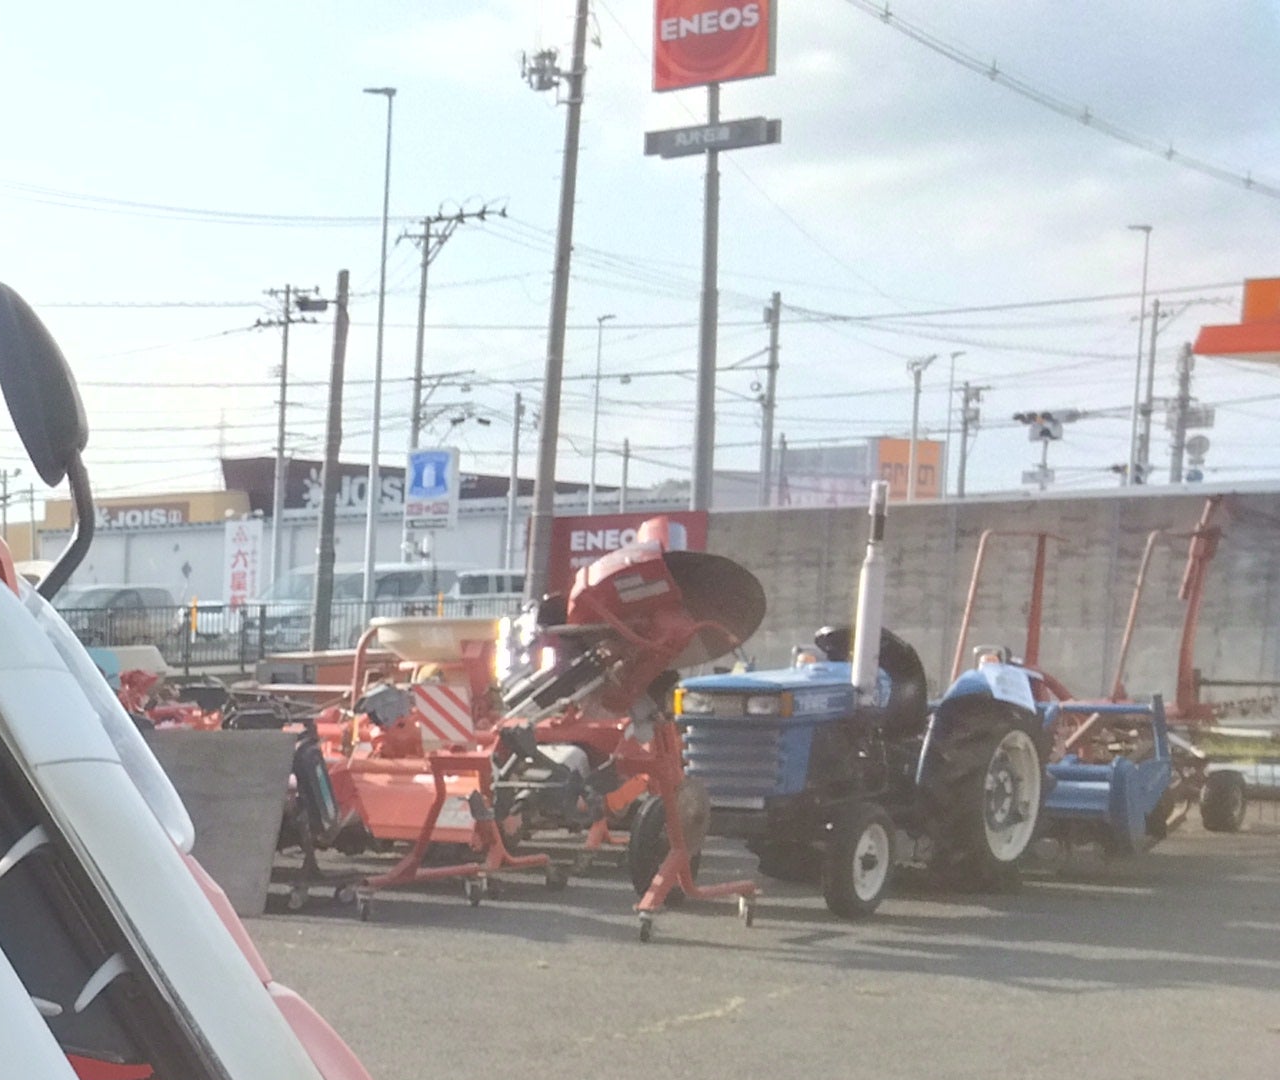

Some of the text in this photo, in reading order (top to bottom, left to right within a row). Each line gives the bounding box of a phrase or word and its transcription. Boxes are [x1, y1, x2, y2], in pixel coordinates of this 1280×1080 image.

[661, 3, 759, 41] ENEOS
[111, 508, 167, 527] JOIS
[570, 528, 642, 551] ENEO
